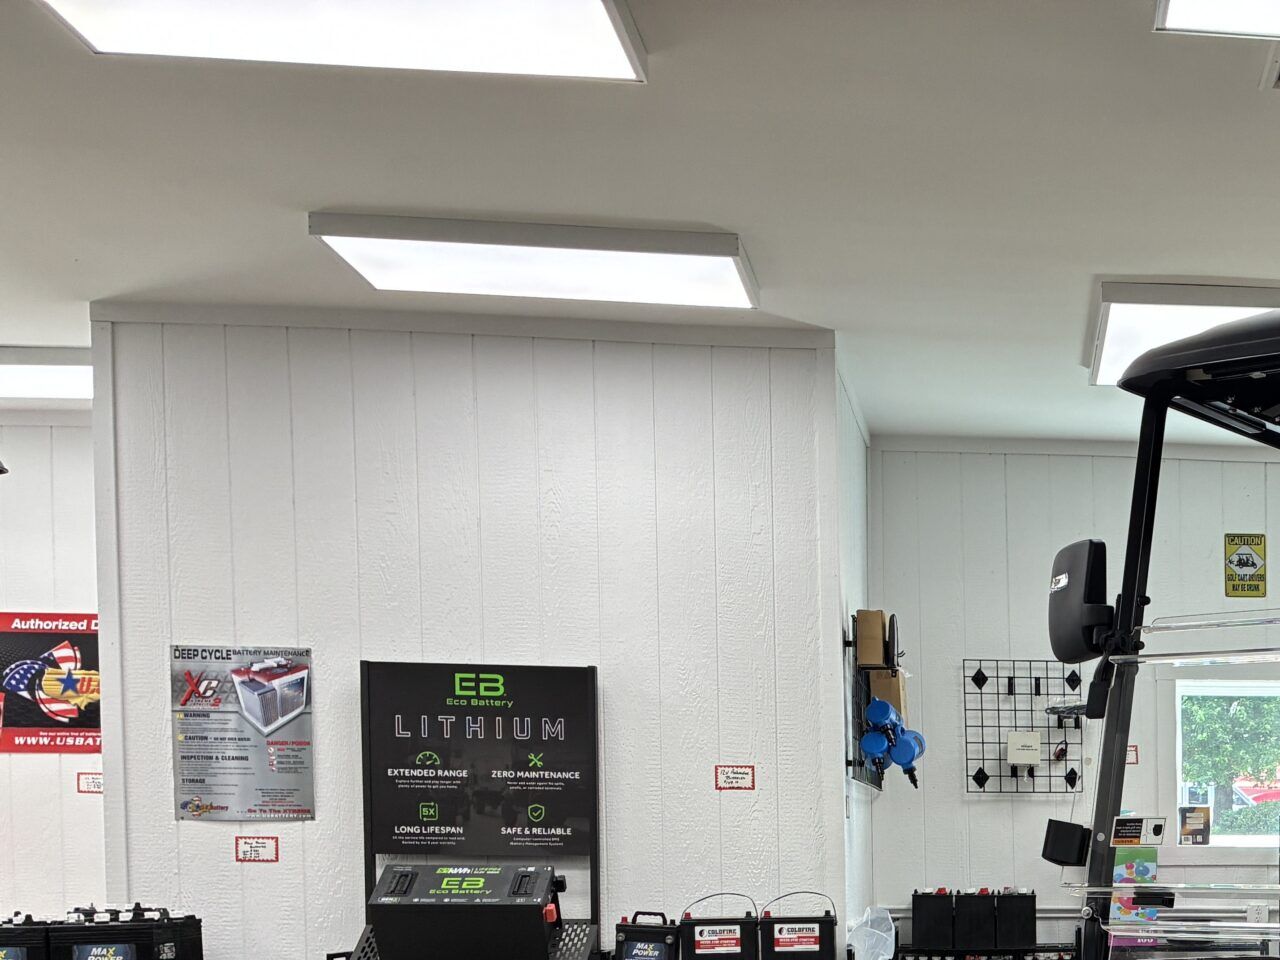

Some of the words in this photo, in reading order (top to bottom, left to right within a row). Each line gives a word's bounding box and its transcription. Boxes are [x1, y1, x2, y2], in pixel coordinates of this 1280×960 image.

[1229, 536, 1261, 545] CAUTION
[11, 618, 87, 630] Authorized
[174, 649, 199, 660] DEEP
[201, 649, 232, 660] CYCLE
[454, 673, 507, 697] EB
[446, 698, 467, 706] Eco
[470, 698, 514, 708] Battery
[395, 714, 565, 740] LITHIUM
[387, 768, 436, 777] EXTENDED
[437, 769, 468, 778] RANGE
[491, 770, 515, 778] ZERO
[516, 771, 581, 779] MAINTENANCE
[422, 807, 435, 816] 5X
[394, 826, 419, 834] LONG
[420, 826, 464, 834] LIFESPAN
[500, 827, 522, 835] SAFE
[524, 827, 530, 835] &
[531, 828, 572, 836] RELIABLE
[441, 877, 486, 889] EB
[635, 942, 655, 950] MAX
[90, 947, 116, 956] MAX
[632, 949, 660, 957] POWER
